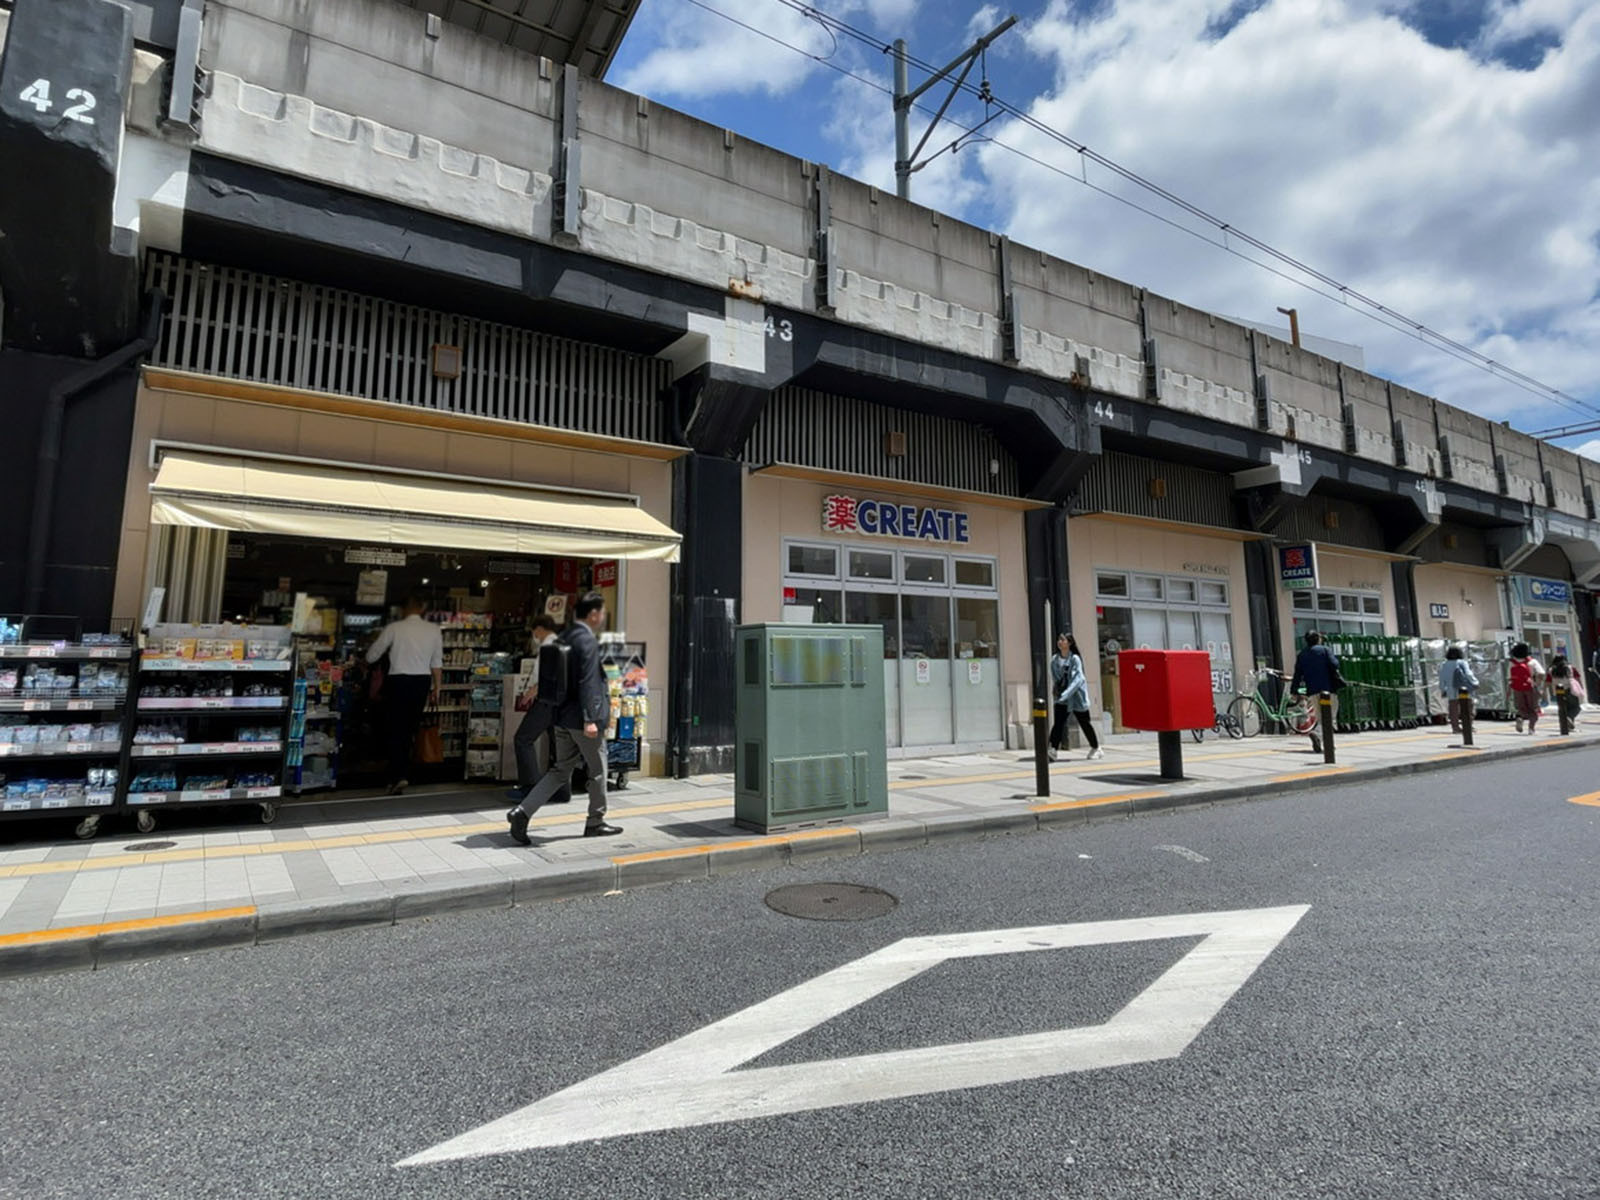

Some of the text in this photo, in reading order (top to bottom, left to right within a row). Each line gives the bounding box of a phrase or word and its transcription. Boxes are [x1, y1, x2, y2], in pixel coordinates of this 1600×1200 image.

[19, 78, 97, 125] 42
[764, 315, 793, 342] 43
[1094, 400, 1114, 420] 44
[1298, 449, 1312, 465] 45
[827, 495, 969, 543] 薬 CREATE
[1283, 568, 1312, 577] CREATE
